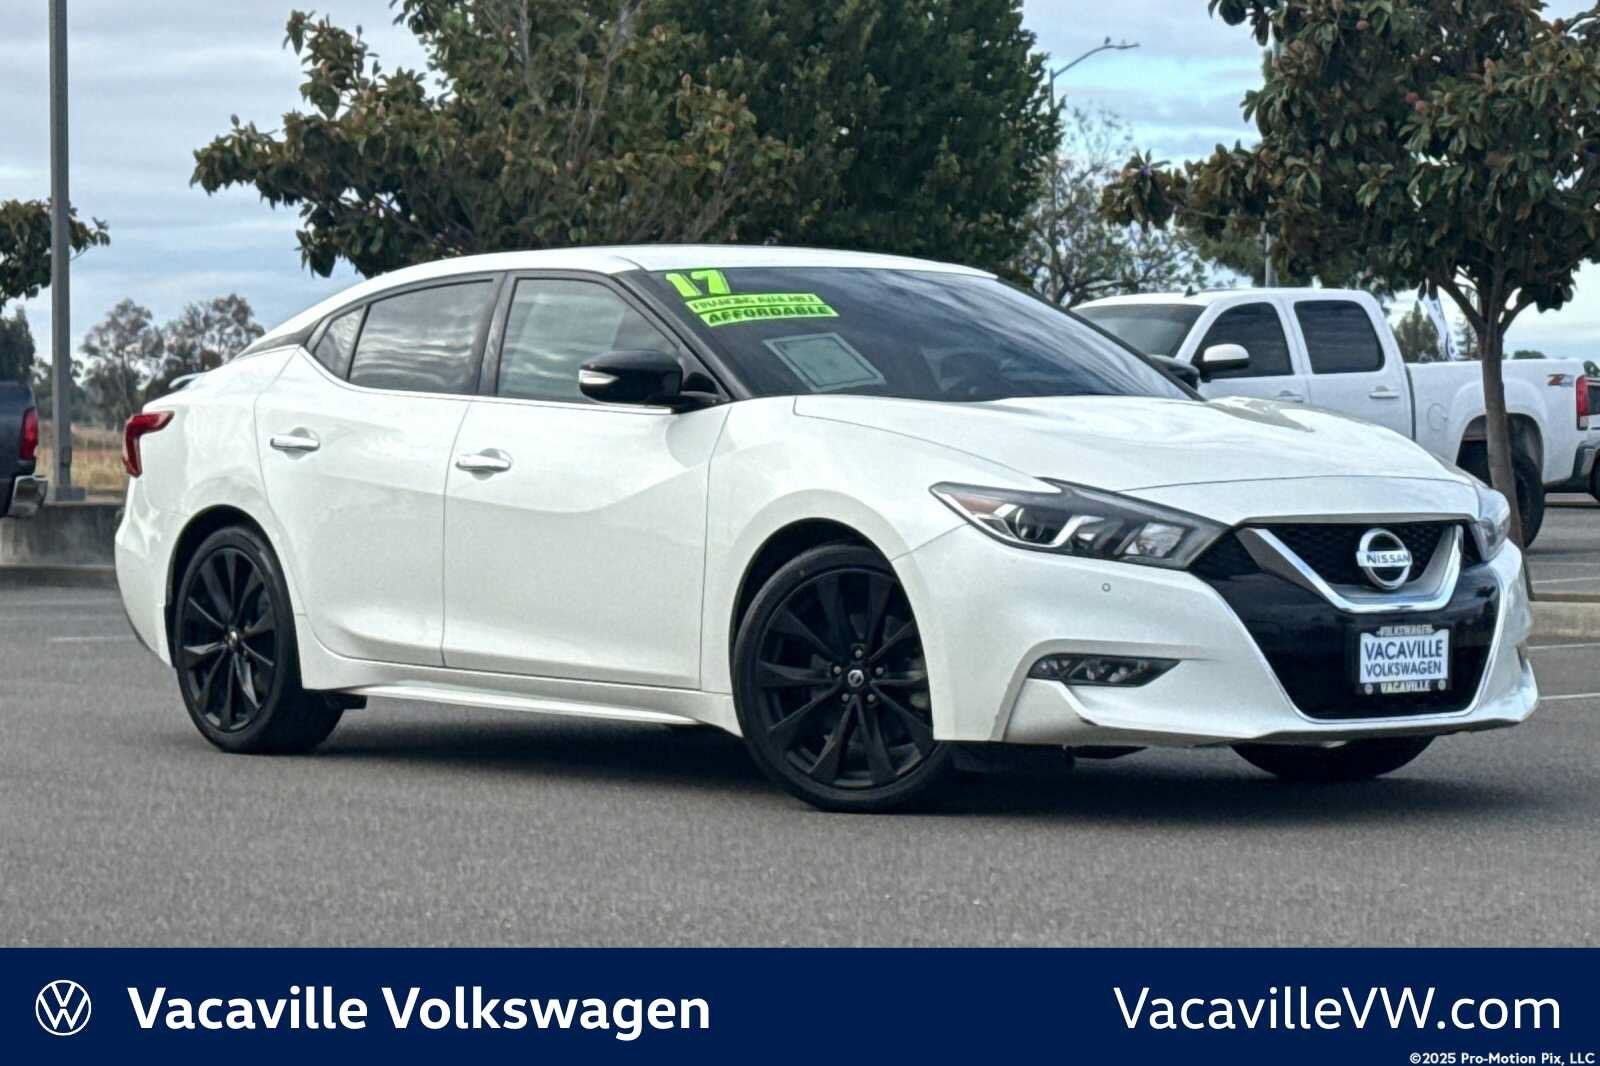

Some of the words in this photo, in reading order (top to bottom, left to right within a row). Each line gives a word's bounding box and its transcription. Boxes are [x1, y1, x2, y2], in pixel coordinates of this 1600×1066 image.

[665, 268, 731, 298] 17
[708, 305, 833, 325] AFFORDABLE
[1366, 552, 1411, 564] NISSAN
[1364, 639, 1444, 662] VACAVILLE
[1365, 660, 1442, 678] VOLKSWAGEN
